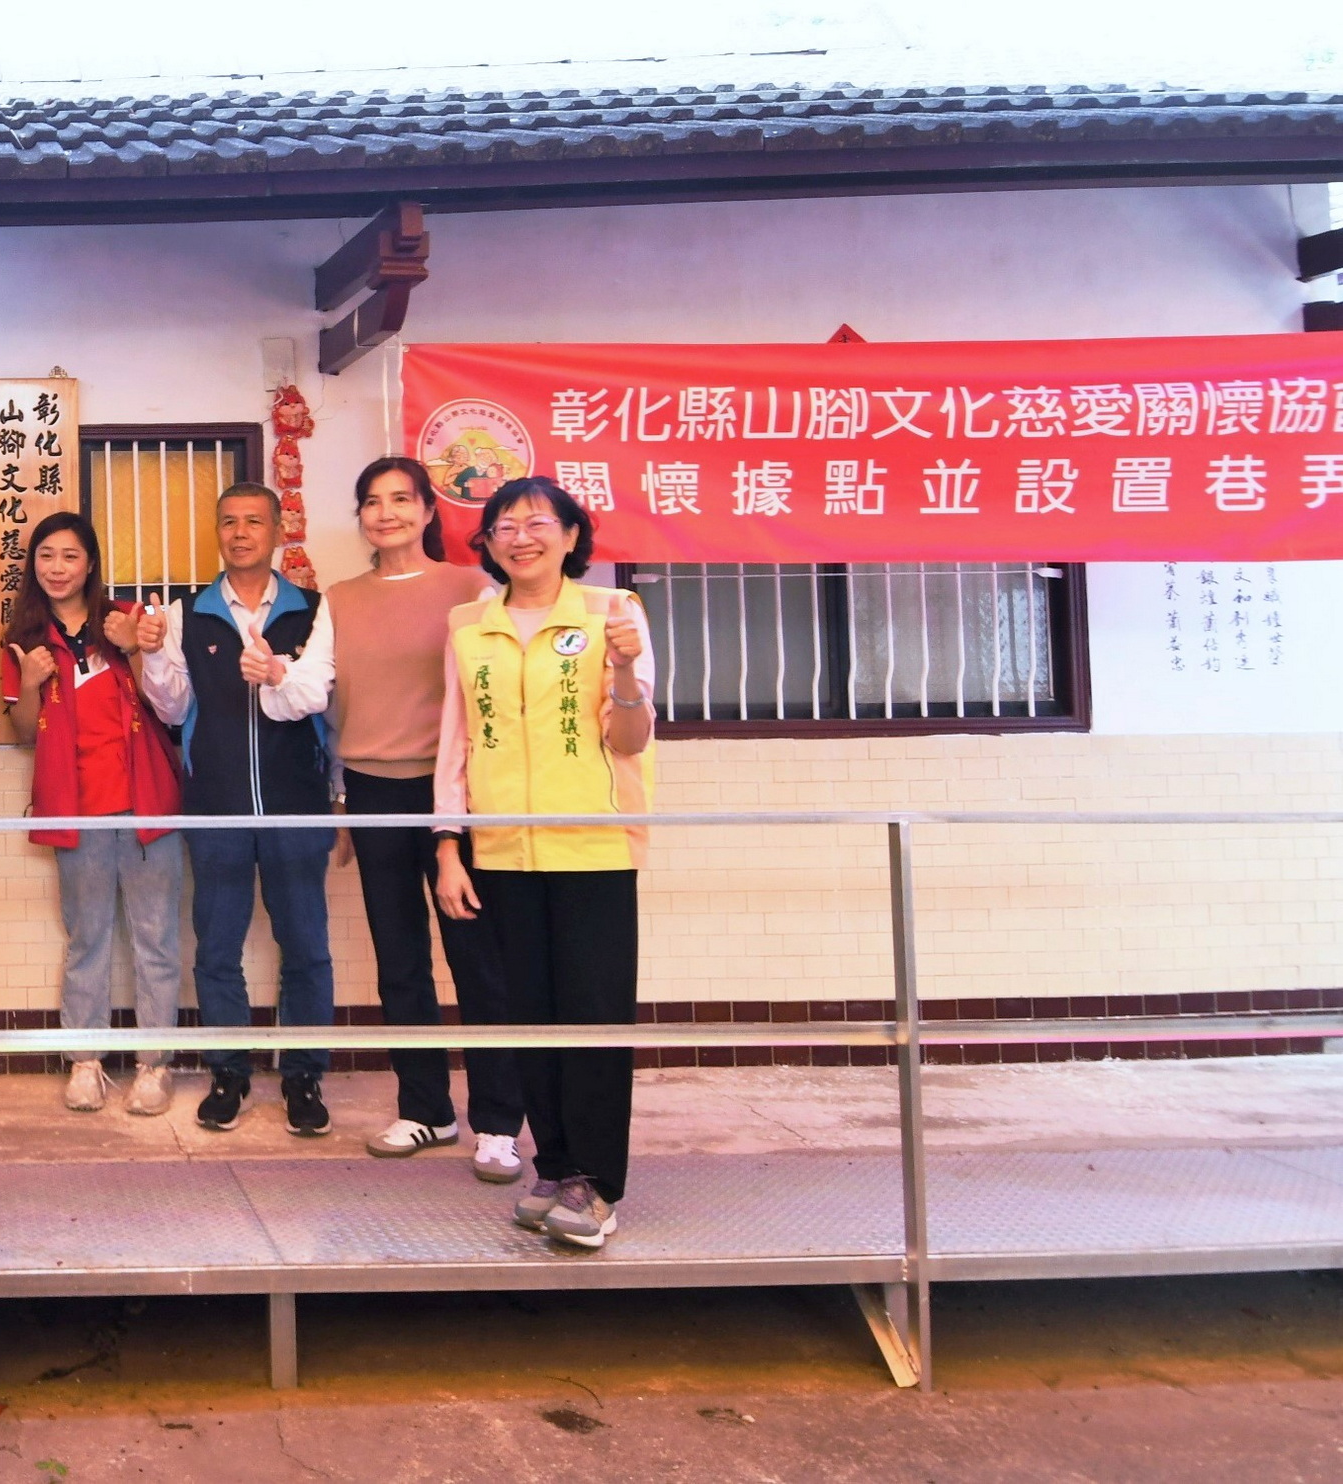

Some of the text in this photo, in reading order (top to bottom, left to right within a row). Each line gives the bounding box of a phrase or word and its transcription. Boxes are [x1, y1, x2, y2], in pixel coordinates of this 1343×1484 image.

[32, 392, 63, 495] 彰化縣
[549, 377, 1343, 444] 彰化縣山腳文化慈愛關懷協
[554, 453, 1343, 517] 關懷據點並設置巷弄
[559, 658, 582, 758] 彰化縣議員
